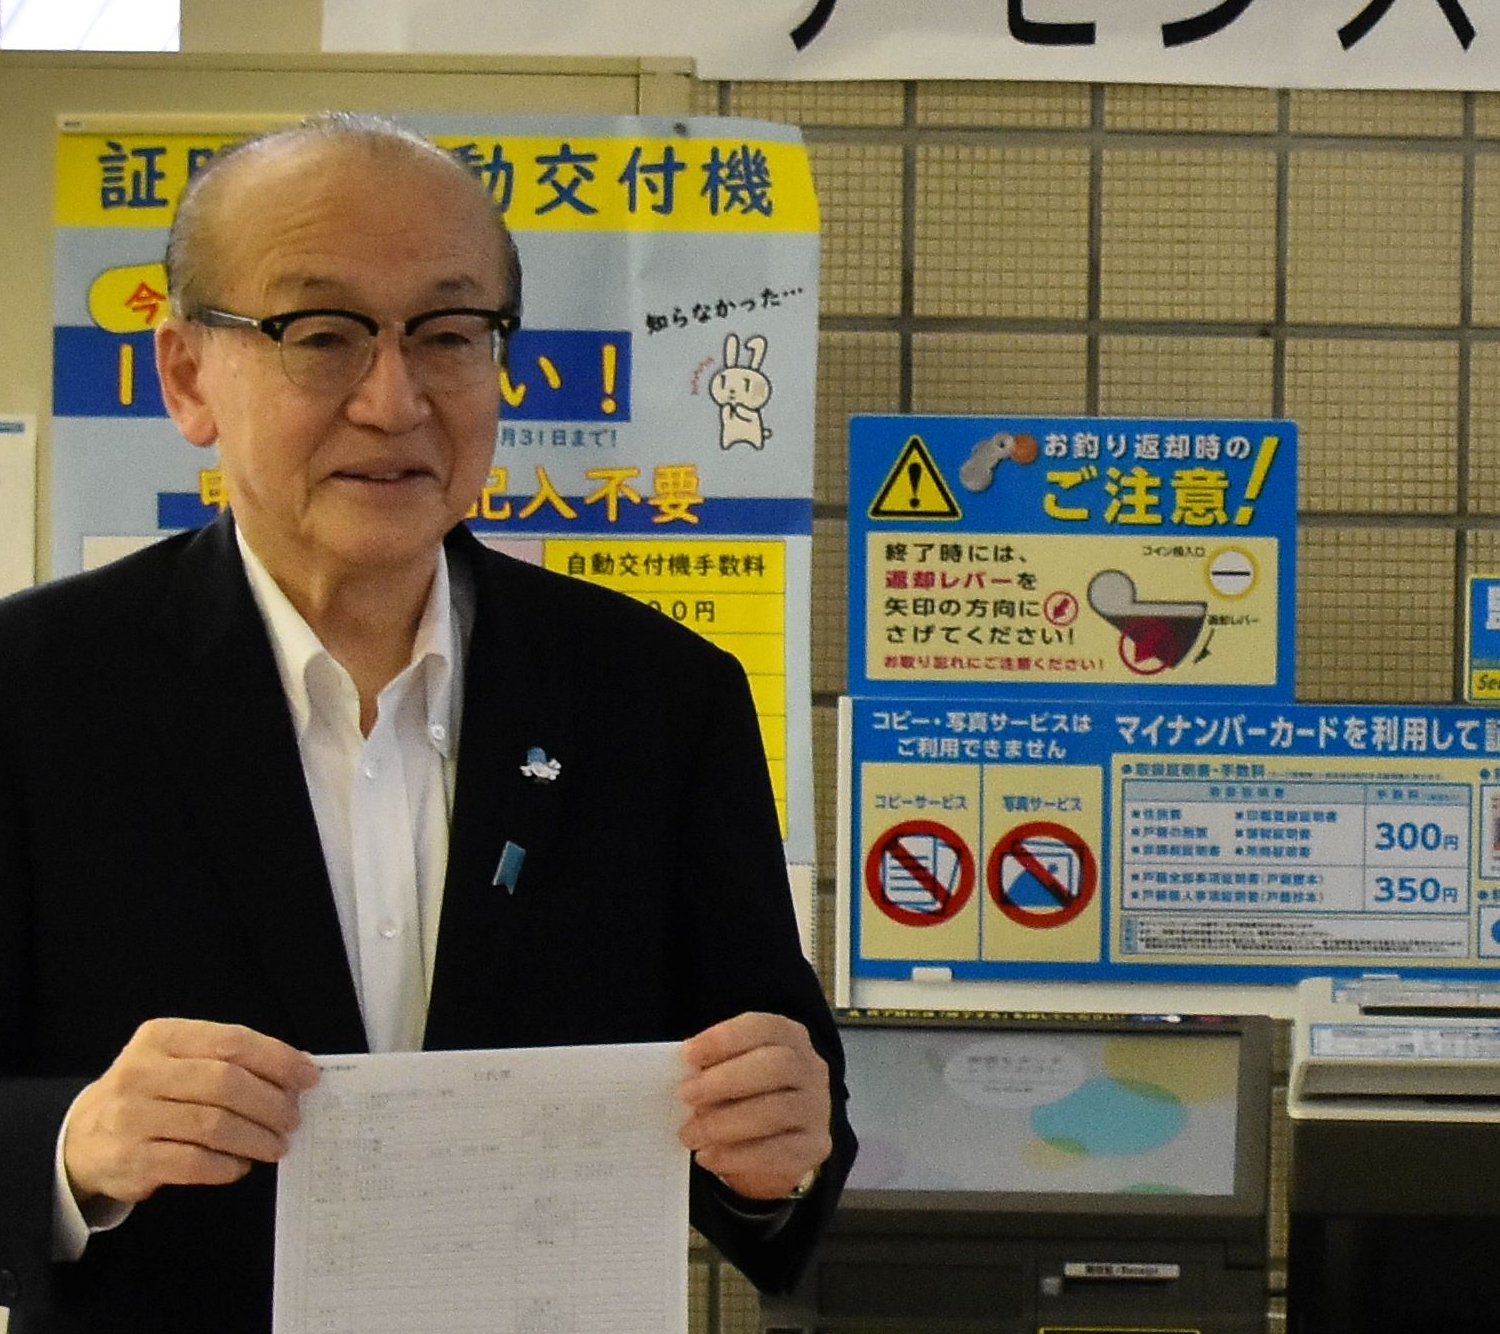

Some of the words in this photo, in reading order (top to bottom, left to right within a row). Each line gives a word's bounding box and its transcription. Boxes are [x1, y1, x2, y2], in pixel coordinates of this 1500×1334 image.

[1043, 432, 1252, 460] お釣り返却時の
[1042, 435, 1280, 527] ご注意!
[885, 542, 1028, 564] 終了時には、
[566, 552, 766, 578] 自動交付機手数料
[884, 570, 1039, 591] 返却レバーを
[884, 597, 1042, 619] 矢印の方向に
[885, 625, 1076, 646] さげてください!
[883, 654, 1105, 672] お取り忘れにご注意ください!
[871, 711, 1092, 736] コピー・写真サービスは
[896, 737, 1068, 760] ご利用できません
[873, 794, 969, 811] コピーサービス
[1002, 795, 1083, 813] 写真サービス
[1374, 821, 1460, 852] 300円
[1373, 876, 1459, 904] 350円
